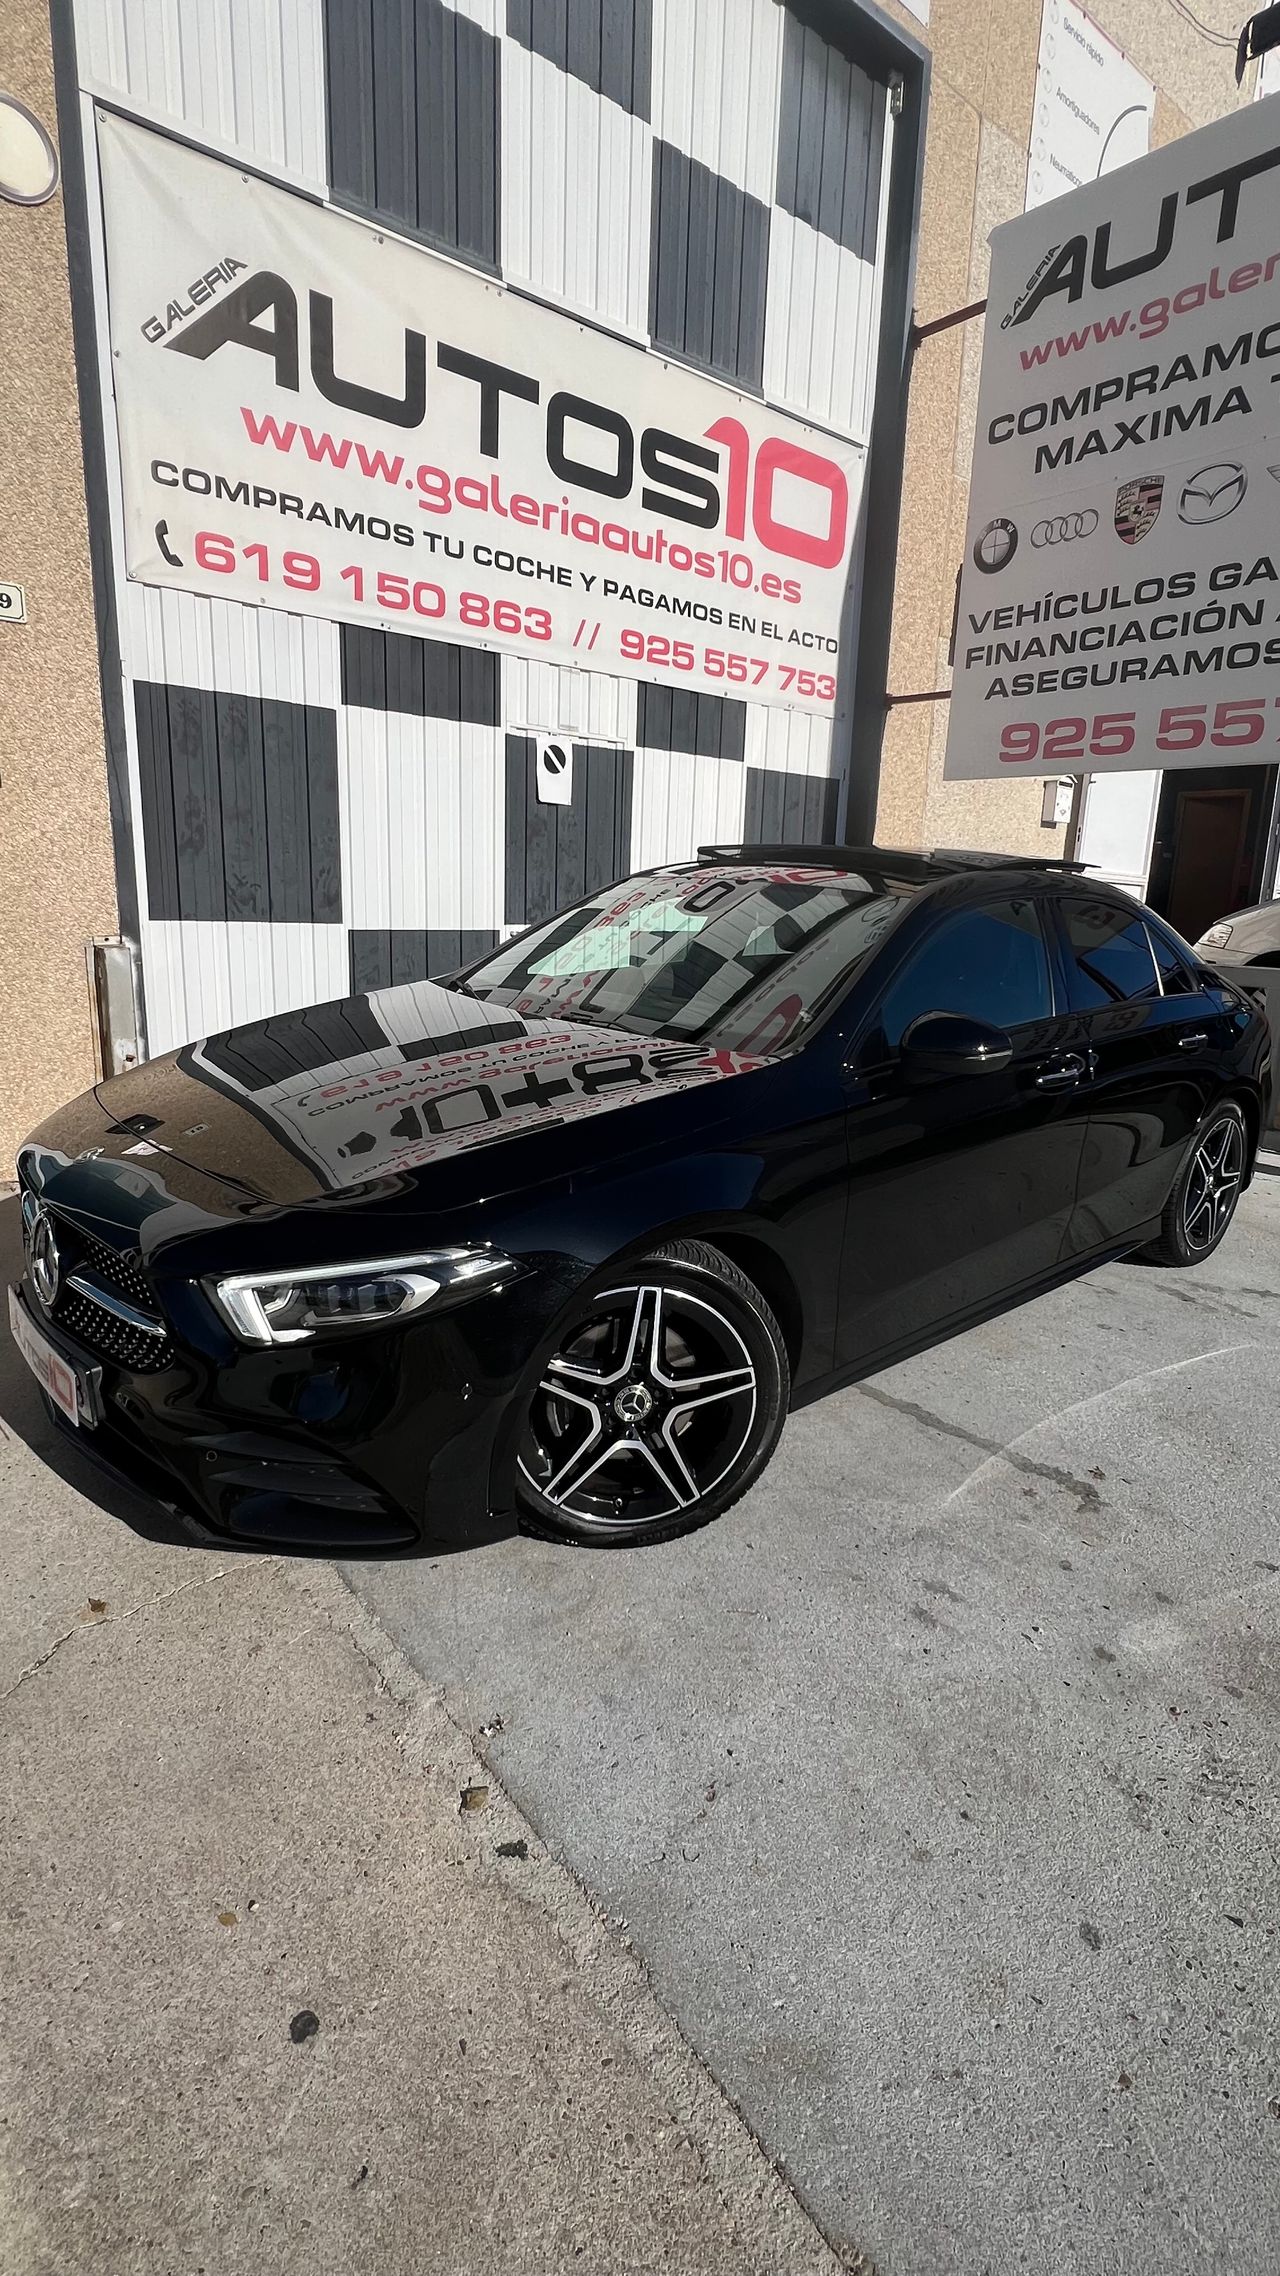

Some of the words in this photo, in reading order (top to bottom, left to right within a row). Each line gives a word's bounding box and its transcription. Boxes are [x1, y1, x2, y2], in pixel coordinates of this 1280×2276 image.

[140, 257, 248, 343] GALERIA
[1000, 244, 1061, 330] GALERIA
[1019, 252, 1280, 371] www.galer
[162, 270, 849, 570] AUTOS10
[1034, 385, 1252, 474] MAXIMA
[240, 406, 801, 604] www.galeriaautos10.es
[150, 459, 415, 547] COMPRAMOS
[422, 530, 464, 559] TU
[473, 545, 572, 587] COCHE
[579, 572, 597, 592] Y
[603, 579, 722, 625] PAGAMOS
[729, 612, 756, 634] EN
[761, 622, 783, 641] EL
[788, 629, 839, 654] ACTO
[968, 571, 1197, 634] VEHÍCULOS
[1209, 557, 1279, 592] GA
[194, 531, 320, 591] 619
[340, 565, 446, 618] 150
[459, 591, 551, 641] 863
[620, 629, 695, 671] 925
[703, 648, 769, 685] 557
[777, 665, 835, 700] 753
[965, 599, 1265, 669] FINANCIACIÓN
[999, 712, 1137, 763] 925
[1155, 695, 1280, 751] 55
